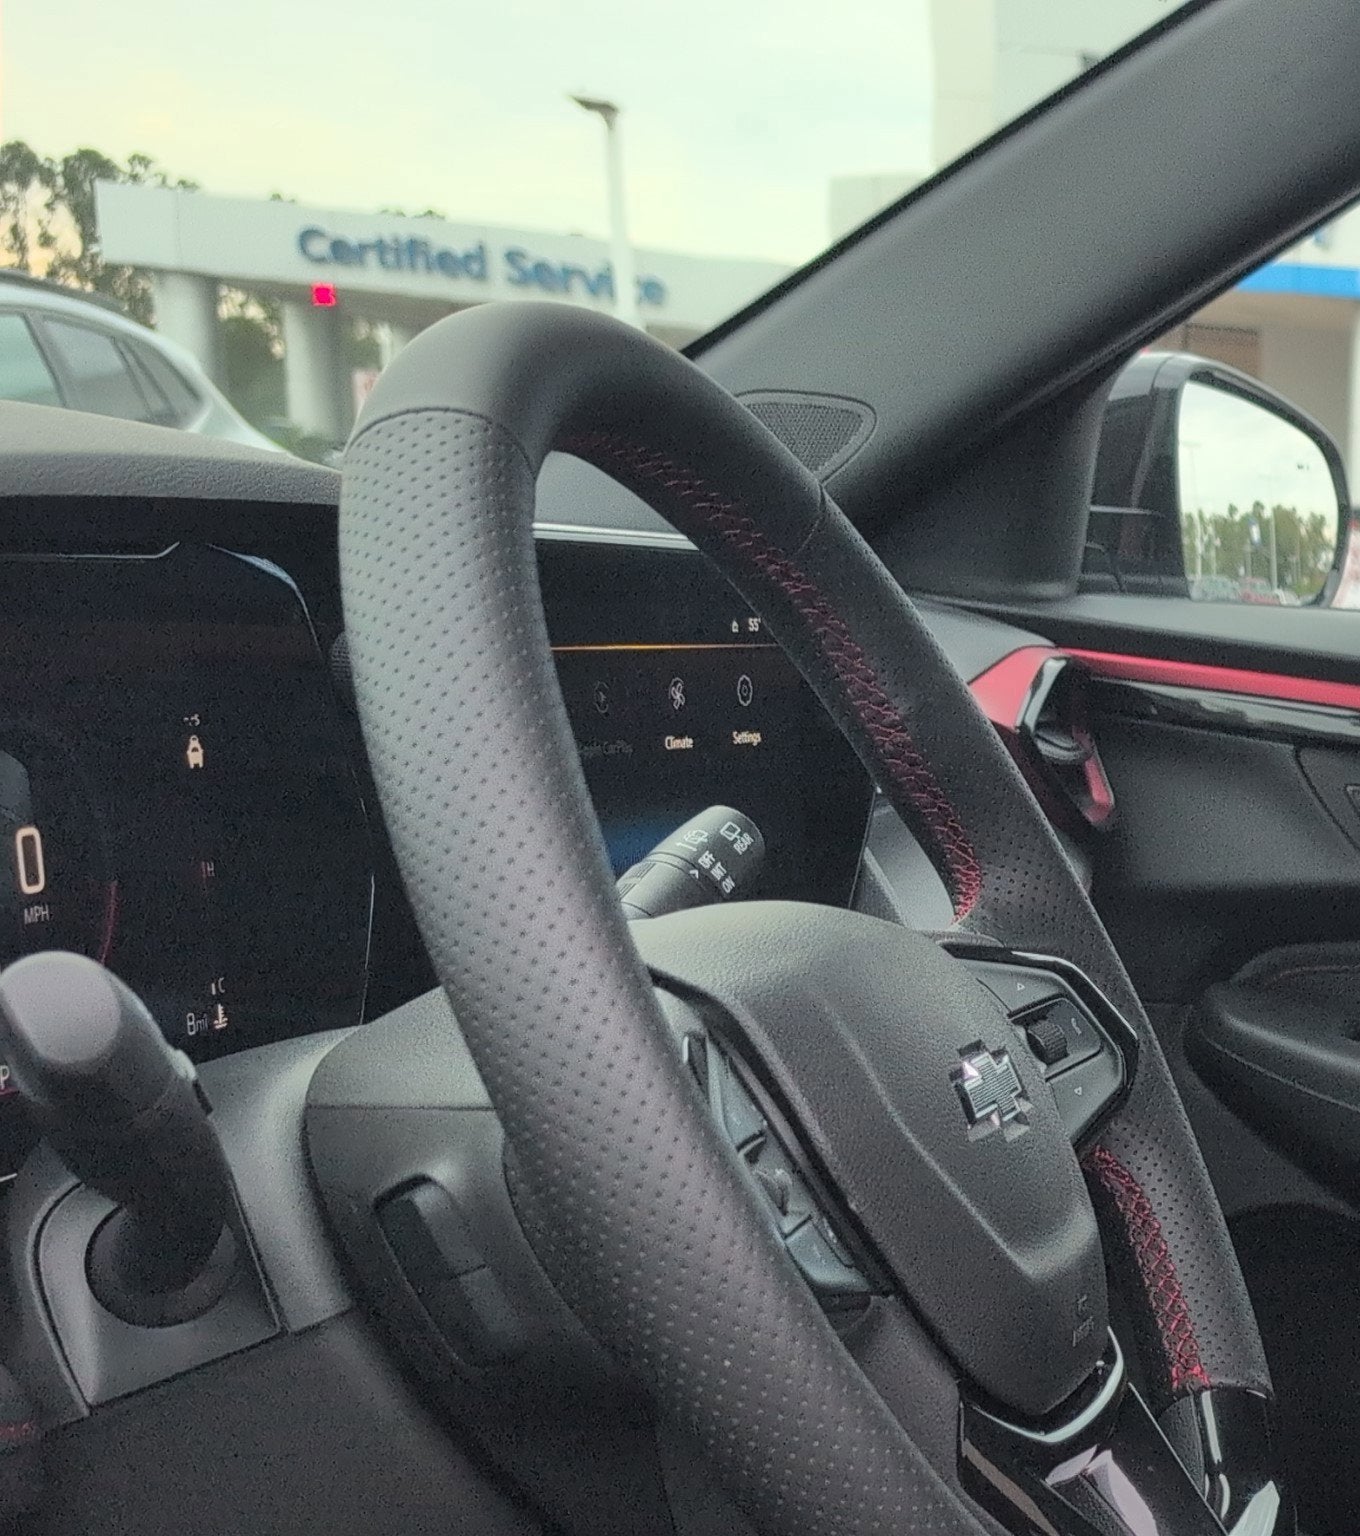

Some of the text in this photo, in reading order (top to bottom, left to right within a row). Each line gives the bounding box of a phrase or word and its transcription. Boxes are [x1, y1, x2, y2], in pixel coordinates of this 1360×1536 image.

[298, 227, 666, 305] Certified Servie
[664, 735, 695, 751] Climate
[732, 731, 763, 747] Settings
[733, 832, 755, 856] REAR
[15, 826, 46, 895] 0
[722, 876, 736, 894] ON
[24, 904, 50, 925] MPH
[0, 1064, 11, 1091] P
